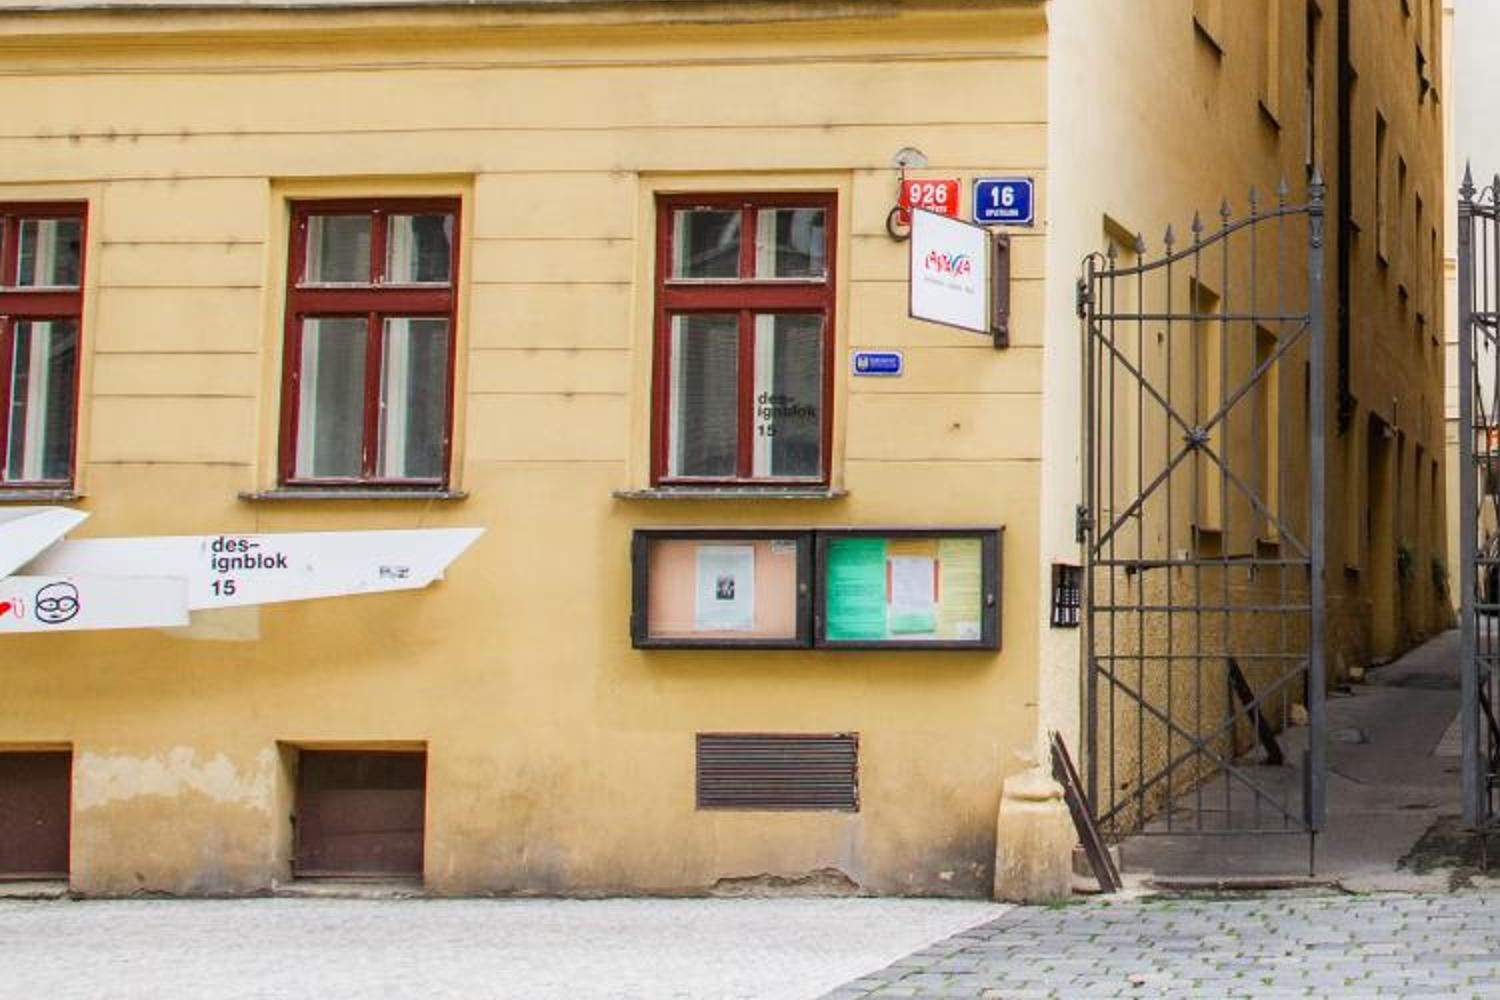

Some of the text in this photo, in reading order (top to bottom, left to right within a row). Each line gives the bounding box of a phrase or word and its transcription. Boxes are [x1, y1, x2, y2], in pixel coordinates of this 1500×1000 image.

[909, 183, 947, 204] 926
[991, 186, 1014, 206] 16
[211, 536, 261, 552] des-
[211, 552, 288, 573] ignblok
[211, 580, 236, 596] 15
